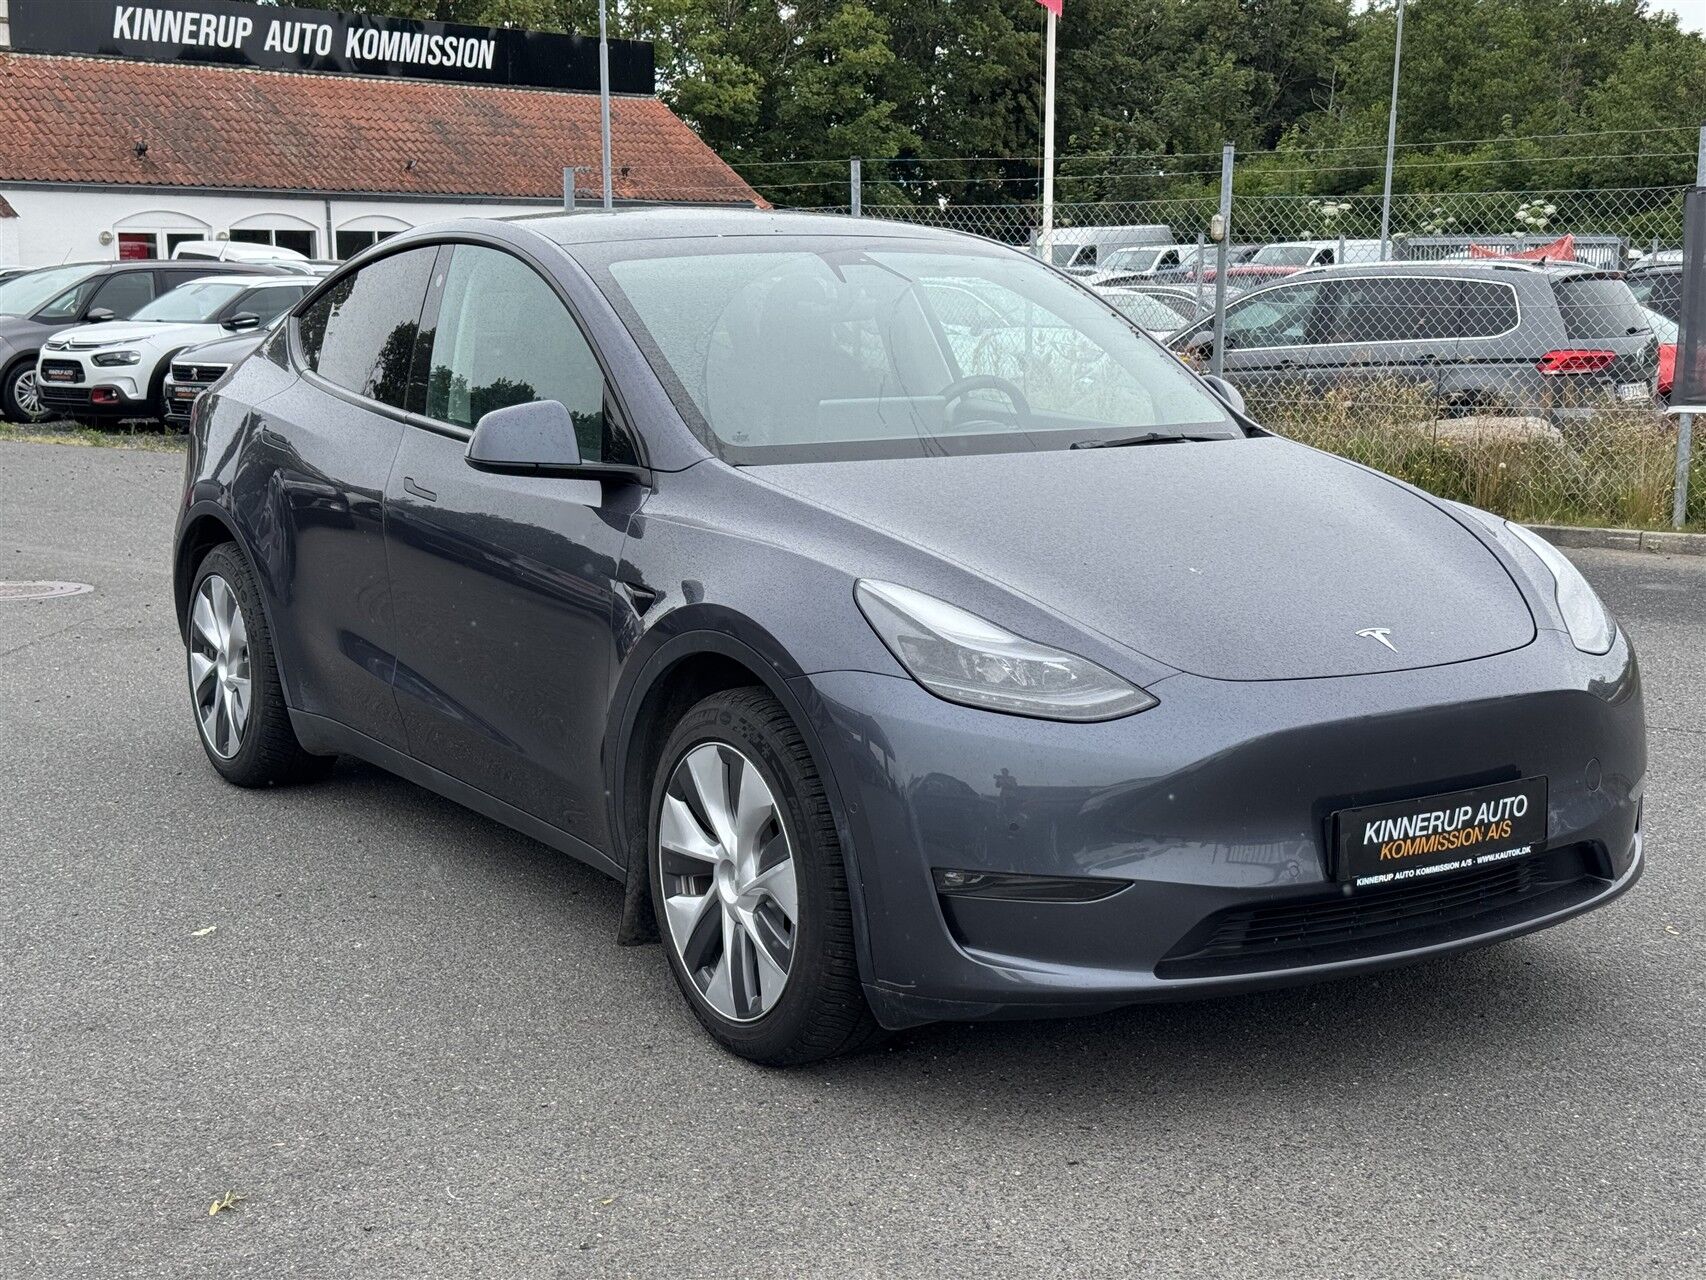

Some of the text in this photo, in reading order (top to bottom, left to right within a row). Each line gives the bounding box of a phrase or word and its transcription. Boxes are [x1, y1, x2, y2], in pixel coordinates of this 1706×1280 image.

[113, 5, 496, 70] KINNERUP AUTO KOMMISSION
[1363, 794, 1528, 845] KINNERUP AUTO
[1380, 820, 1512, 860] KOMMISSION A/S
[1356, 873, 1394, 887] KINNERUP
[1394, 869, 1415, 880] AUTO
[1415, 861, 1460, 876] KOMMISSION
[1460, 858, 1473, 868] A/S
[1477, 846, 1532, 864] WWW.KAUTOK.DK
